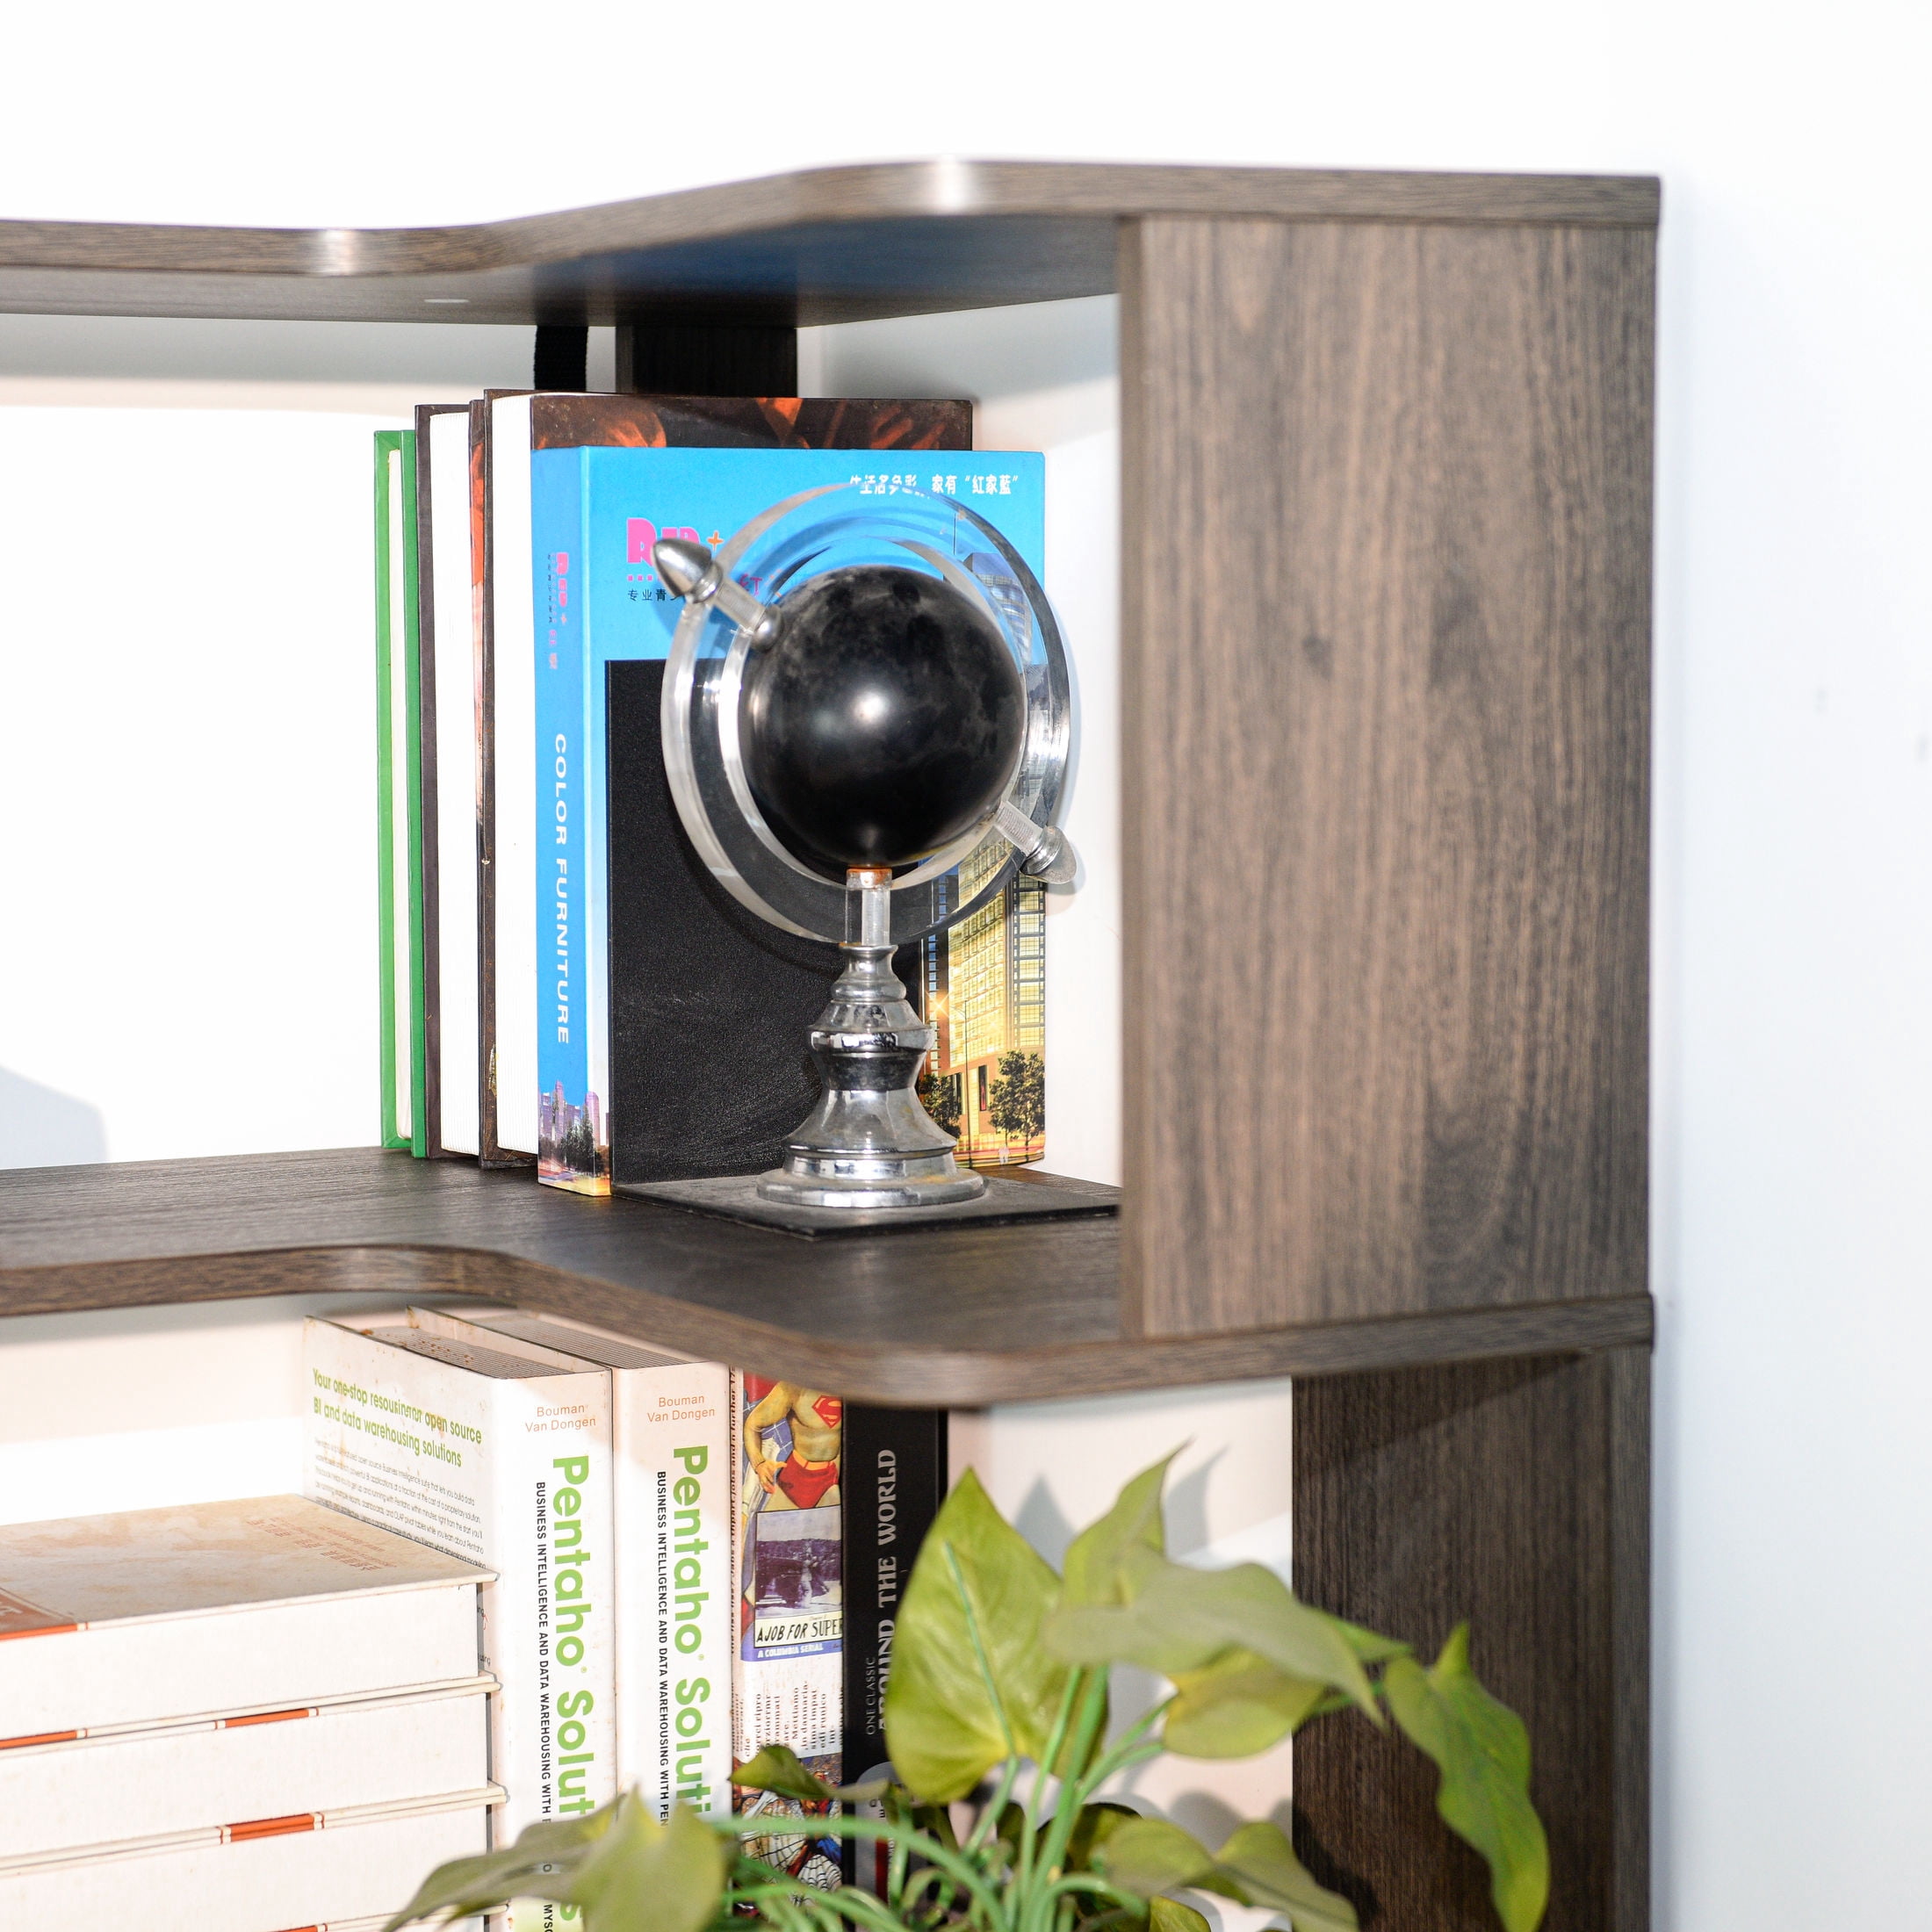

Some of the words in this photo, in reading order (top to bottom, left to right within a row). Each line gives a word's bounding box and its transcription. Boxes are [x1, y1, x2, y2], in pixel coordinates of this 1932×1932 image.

[554, 732, 568, 846] COLOR
[556, 857, 570, 1044] FURNITURE
[313, 1367, 331, 1389] Your
[333, 1379, 367, 1405] one-stop
[424, 1411, 448, 1433] open
[450, 1421, 482, 1445] source
[525, 1422, 547, 1432] Van
[551, 1417, 596, 1431] Dongen
[537, 1404, 586, 1417] Bouman
[647, 1412, 668, 1423] Van
[672, 1408, 716, 1422] Dongen
[659, 1395, 704, 1408] Bouman
[314, 1396, 321, 1415] BI
[324, 1402, 340, 1422] and
[342, 1408, 361, 1431] data
[364, 1419, 420, 1456] warehousing
[422, 1440, 462, 1467] solutions
[536, 1481, 546, 1539] BUSINESS
[657, 1471, 667, 1528] BUSINESS
[877, 1449, 897, 1546] WORLD
[553, 1455, 592, 1667] Pentaho
[658, 1532, 667, 1616] INTELLIGENCE
[673, 1445, 710, 1654] Pentaho
[537, 1544, 548, 1628] INTELLIGENCE
[878, 1555, 897, 1608] THE
[539, 1633, 549, 1656] AND
[659, 1620, 667, 1644] AND
[787, 1623, 808, 1640] FOR
[539, 1660, 550, 1690] DATA
[659, 1647, 668, 1676] DATA
[866, 1656, 876, 1705] CLASSIC
[540, 1693, 551, 1780] WAREHOUSING
[660, 1680, 669, 1766] WAREHOUSING
[866, 1709, 876, 1735] ONE
[542, 1784, 551, 1814] WITH
[660, 1770, 669, 1800] WITH
